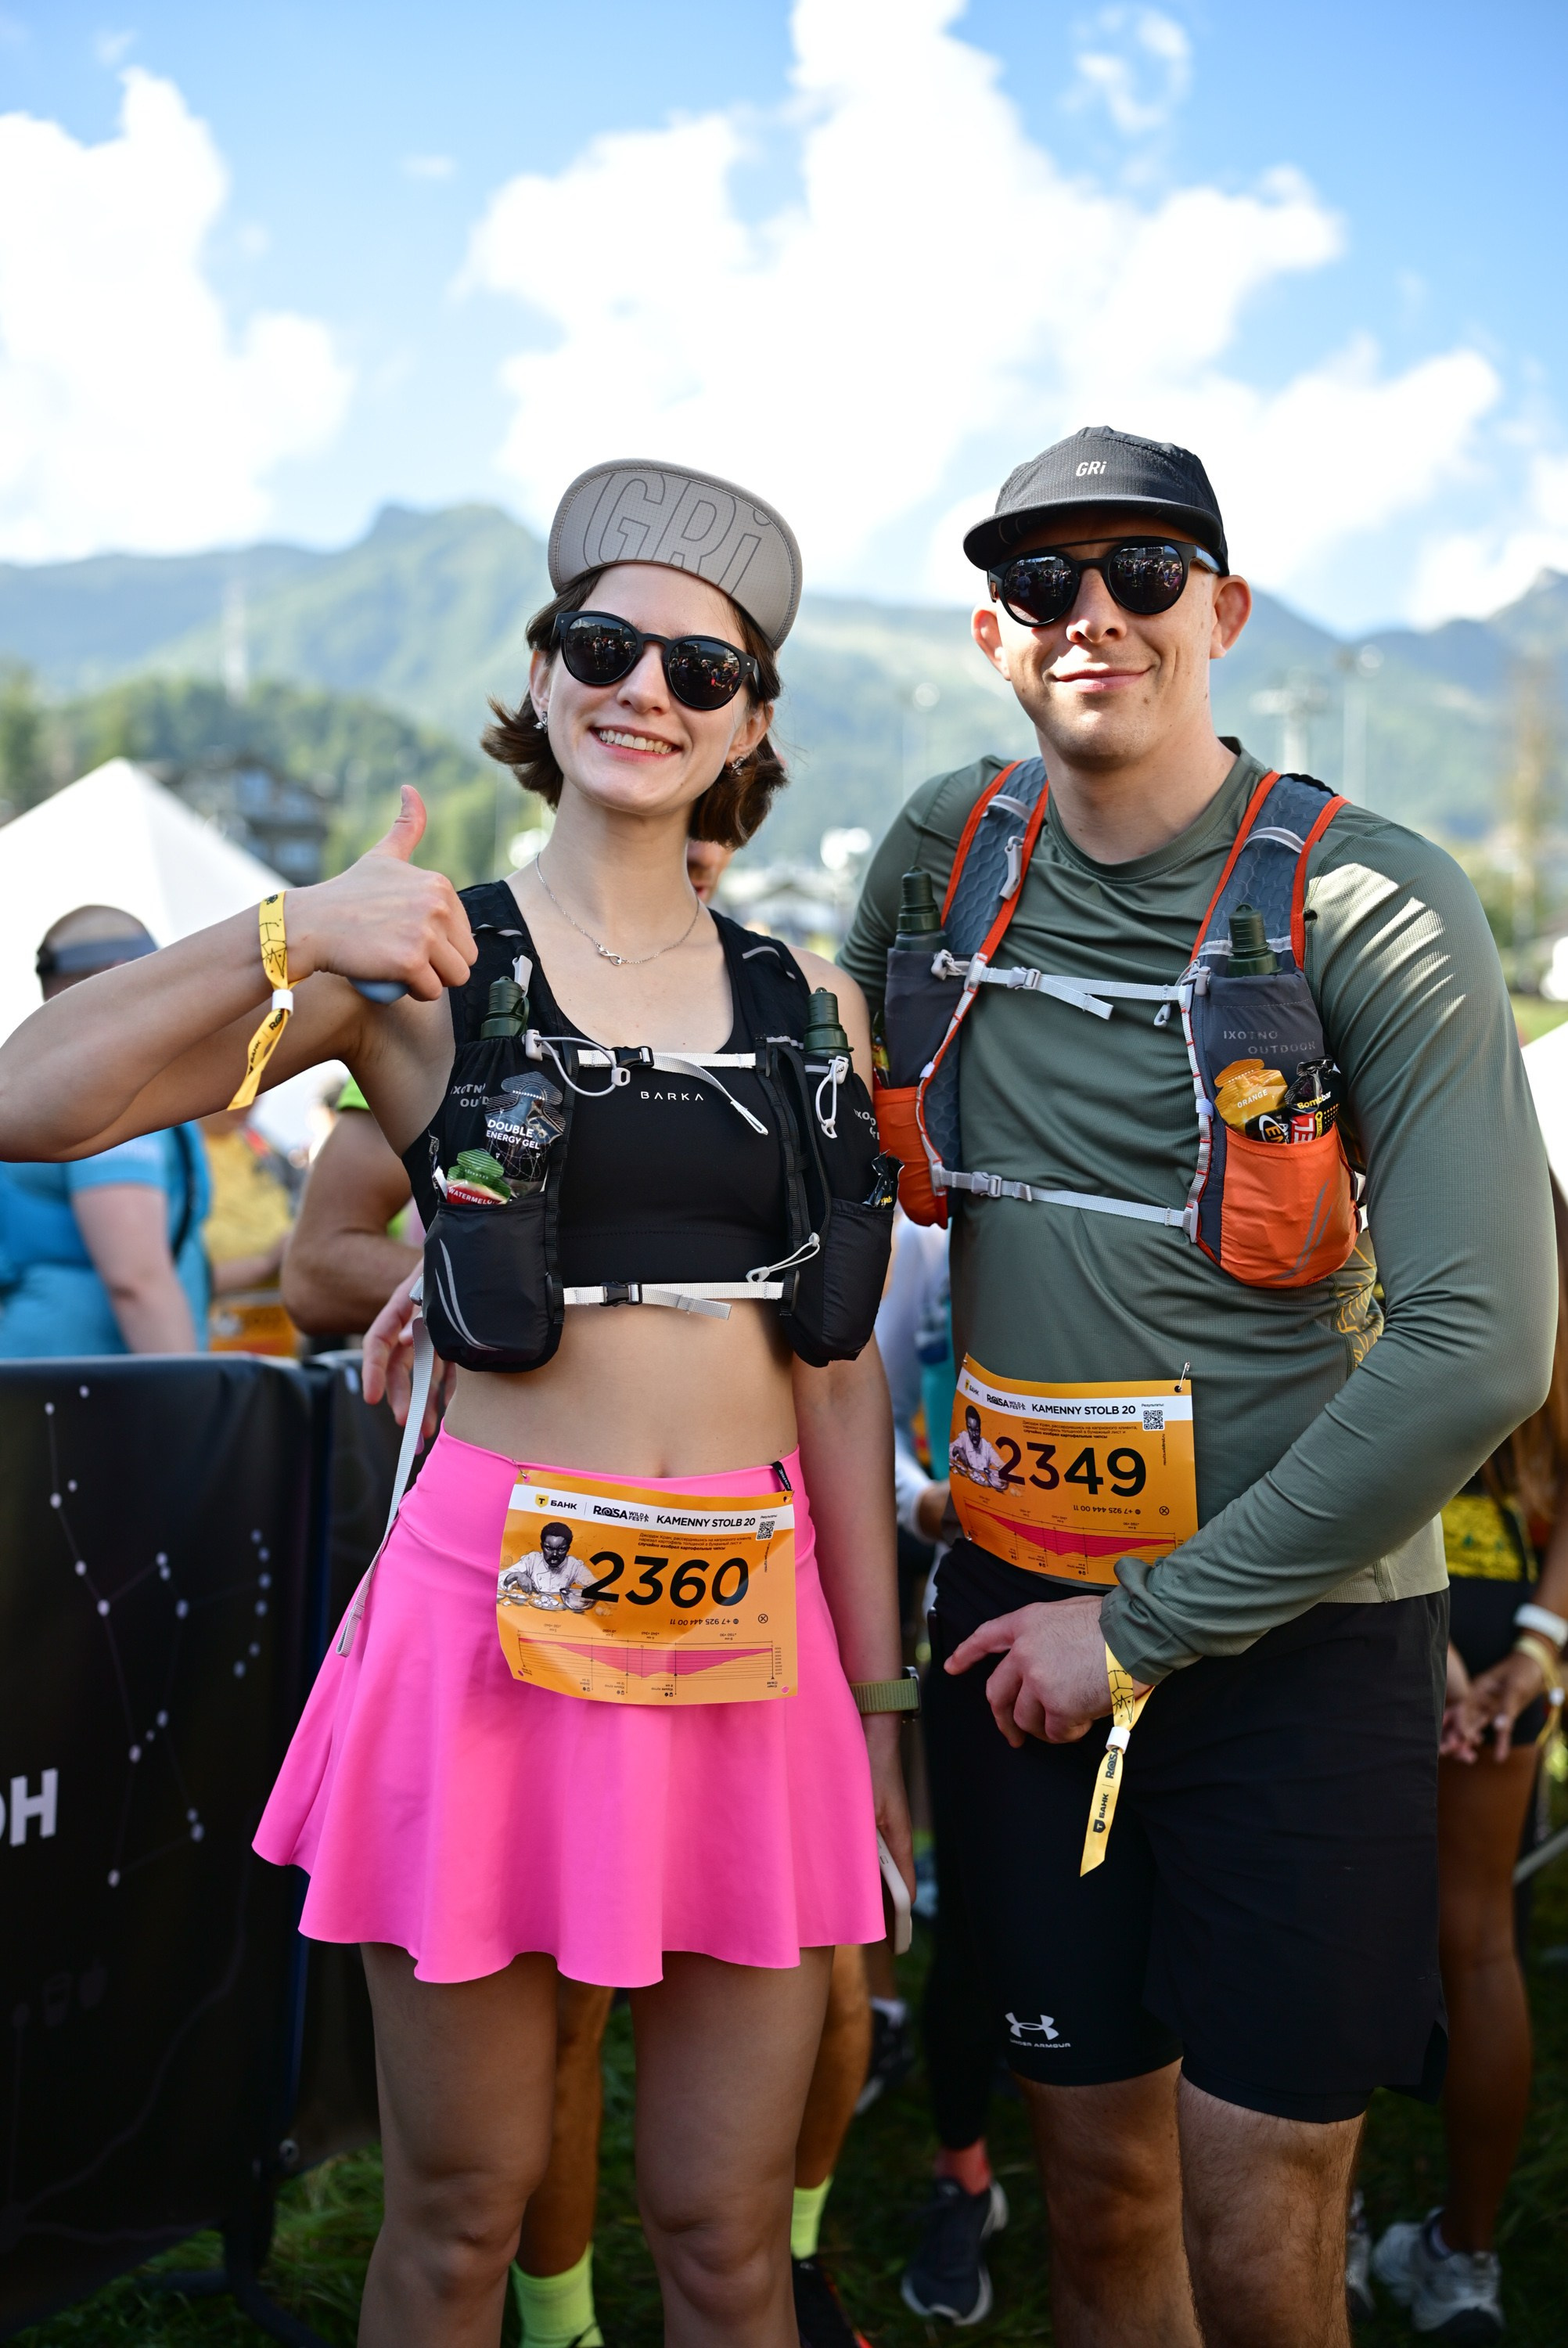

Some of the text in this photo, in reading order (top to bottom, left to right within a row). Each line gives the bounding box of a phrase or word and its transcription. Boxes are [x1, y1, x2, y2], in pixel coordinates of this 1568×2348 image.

[1076, 461, 1107, 477] GRi
[269, 1009, 283, 1031] RO
[1224, 1030, 1278, 1040] IXOTNO
[1248, 1040, 1316, 1054] OUTDOOR
[640, 1091, 704, 1101] BARKA
[1237, 1089, 1268, 1108] ORANGE
[1296, 1091, 1332, 1110] Bombbar
[487, 1119, 534, 1138] DOUBLE
[486, 1129, 540, 1150] ENERGY GEL
[448, 1187, 496, 1205] WATERMELO
[987, 1394, 1009, 1408] ROSA
[1031, 1404, 1136, 1415] KAMENNY STOLB 20
[994, 1435, 1147, 1498] 2349
[550, 1500, 577, 1510] БАНК
[593, 1505, 628, 1520] ROSA
[656, 1514, 756, 1527] KAMENNY STOLB 20
[581, 1550, 750, 1608] 2360
[1099, 1793, 1109, 1819] БАНК
